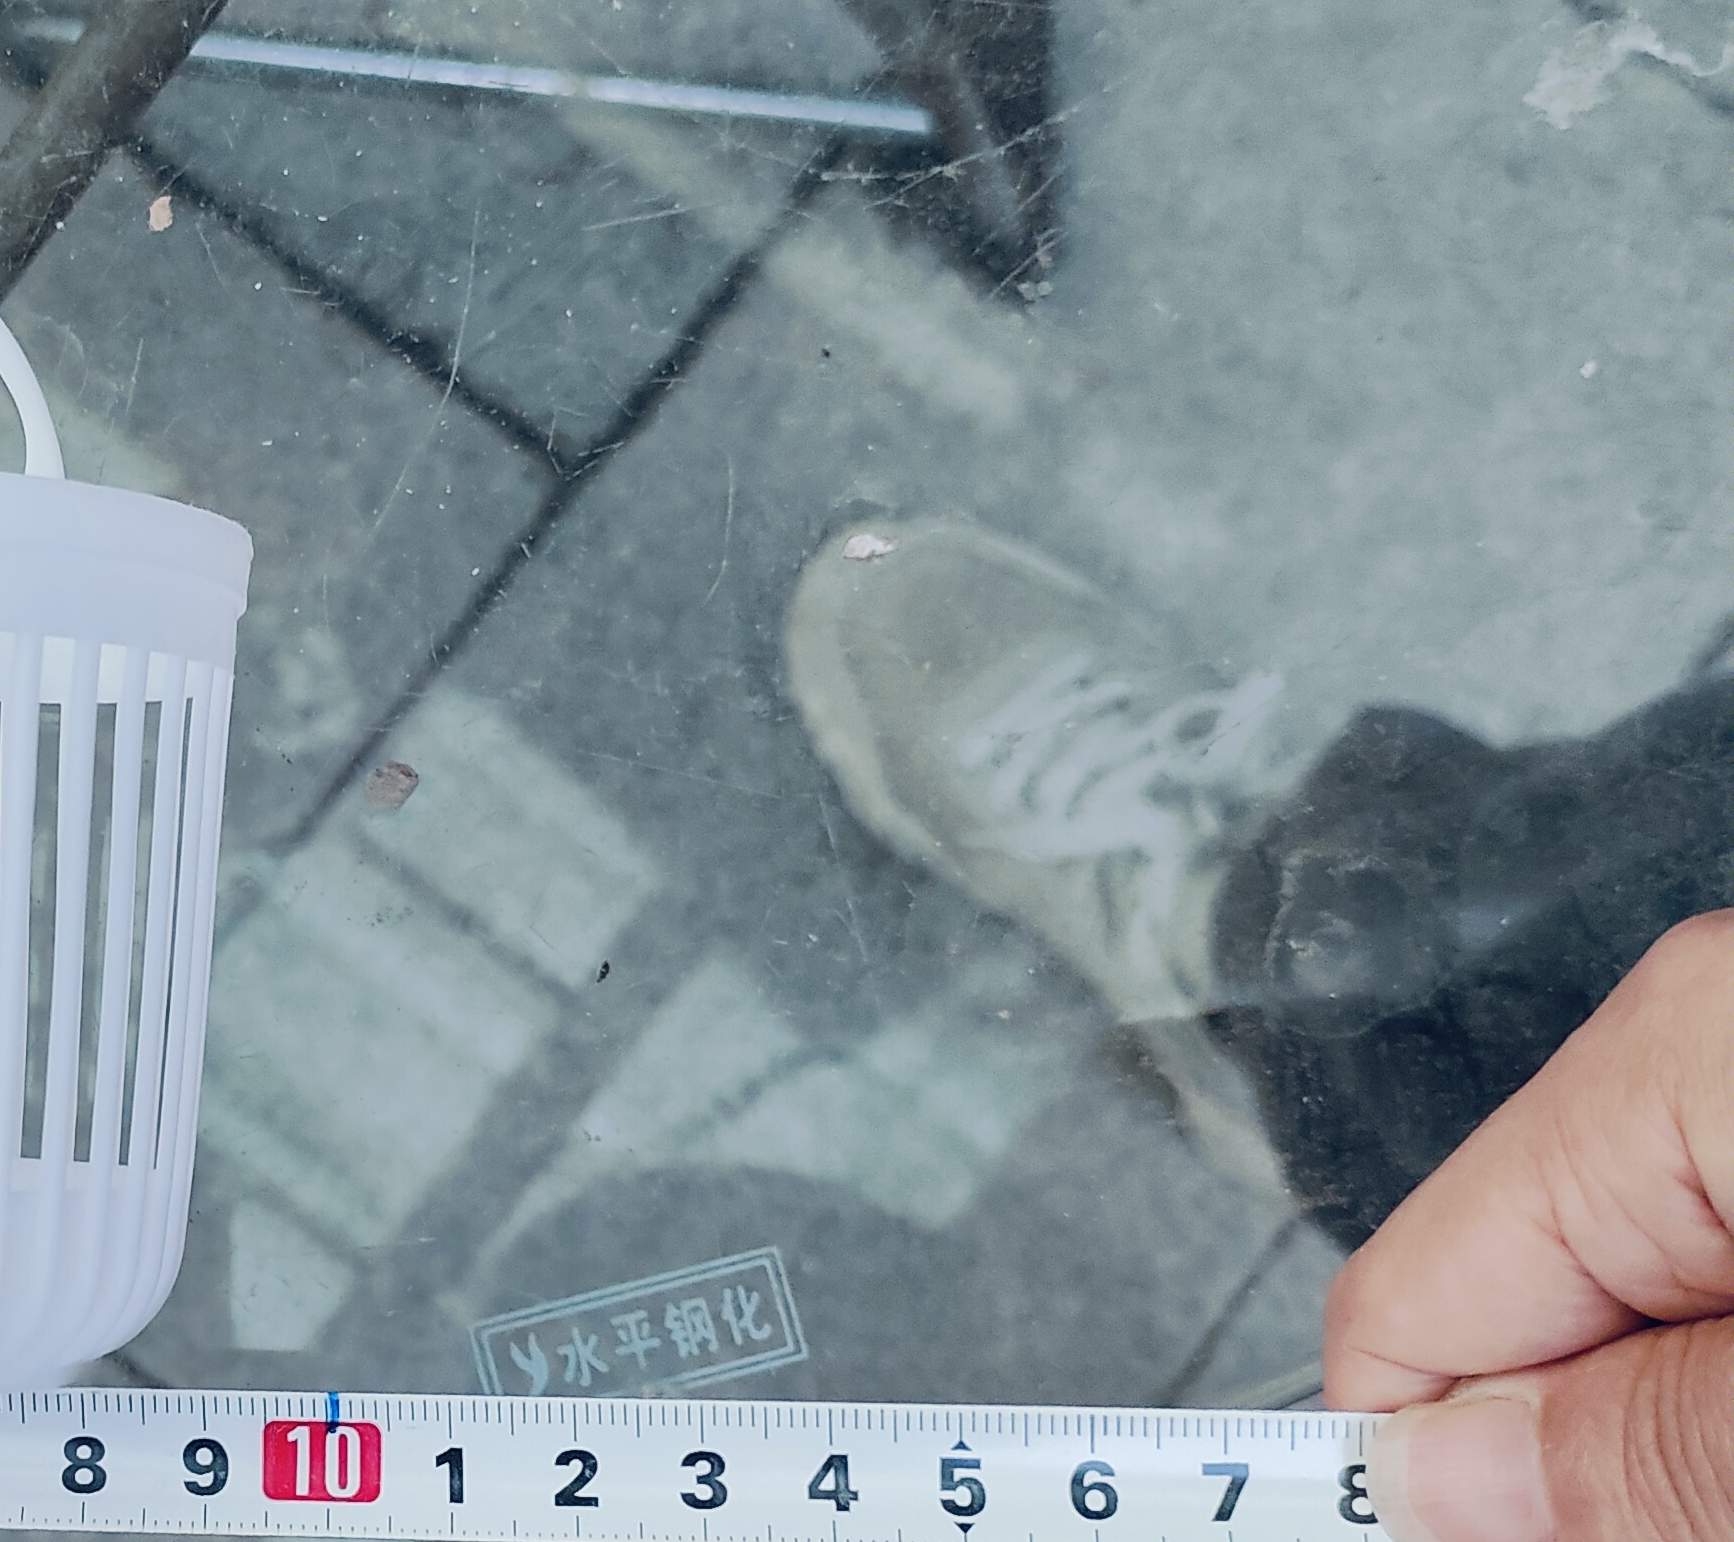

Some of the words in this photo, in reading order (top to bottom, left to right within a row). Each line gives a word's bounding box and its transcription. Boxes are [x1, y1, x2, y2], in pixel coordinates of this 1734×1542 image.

[61, 1436, 107, 1495] 8
[182, 1437, 229, 1497] 9
[284, 1425, 362, 1499] 10
[435, 1447, 464, 1504] 1
[554, 1449, 599, 1508] 2
[680, 1450, 728, 1510] 3
[808, 1454, 859, 1512] 4
[940, 1458, 986, 1517] 5
[1069, 1460, 1119, 1521] 6
[1202, 1463, 1250, 1522] 7
